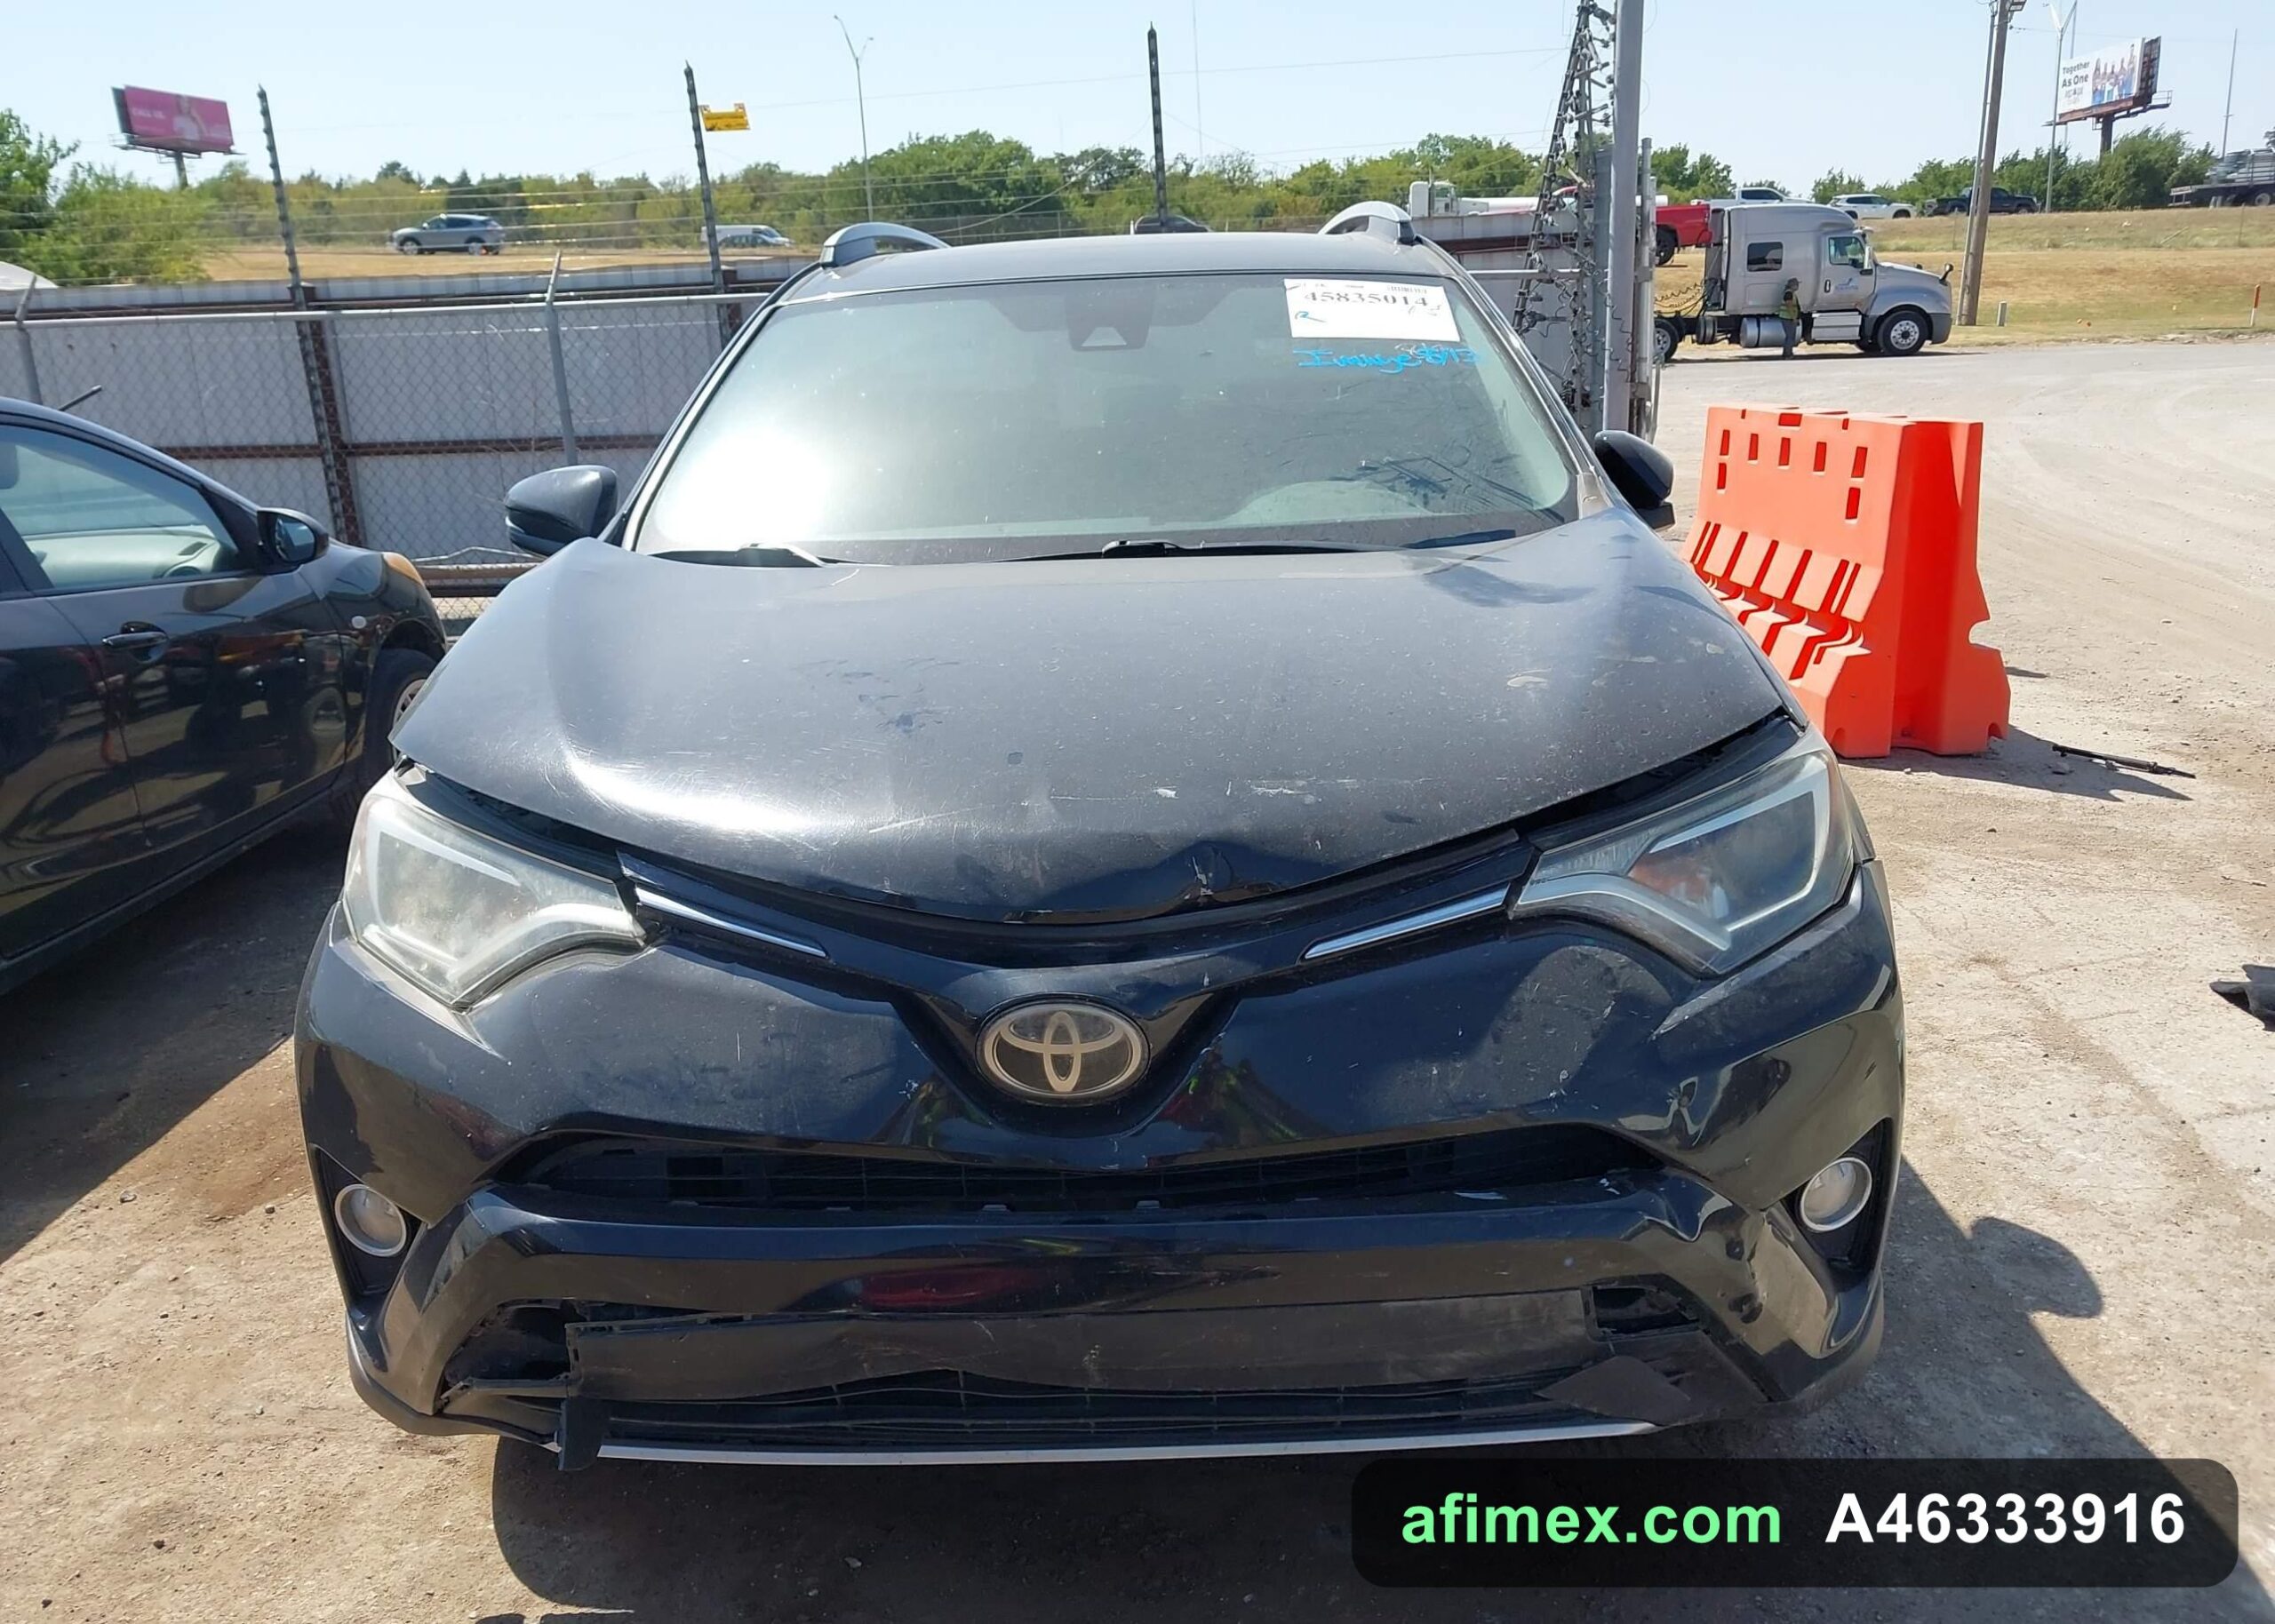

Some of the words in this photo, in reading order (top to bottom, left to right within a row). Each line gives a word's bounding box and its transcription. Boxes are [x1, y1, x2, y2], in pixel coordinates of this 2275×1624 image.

[2063, 61, 2090, 74] Together
[2062, 77, 2072, 88] As
[2073, 74, 2088, 85] One
[1305, 291, 1428, 306] 45835014
